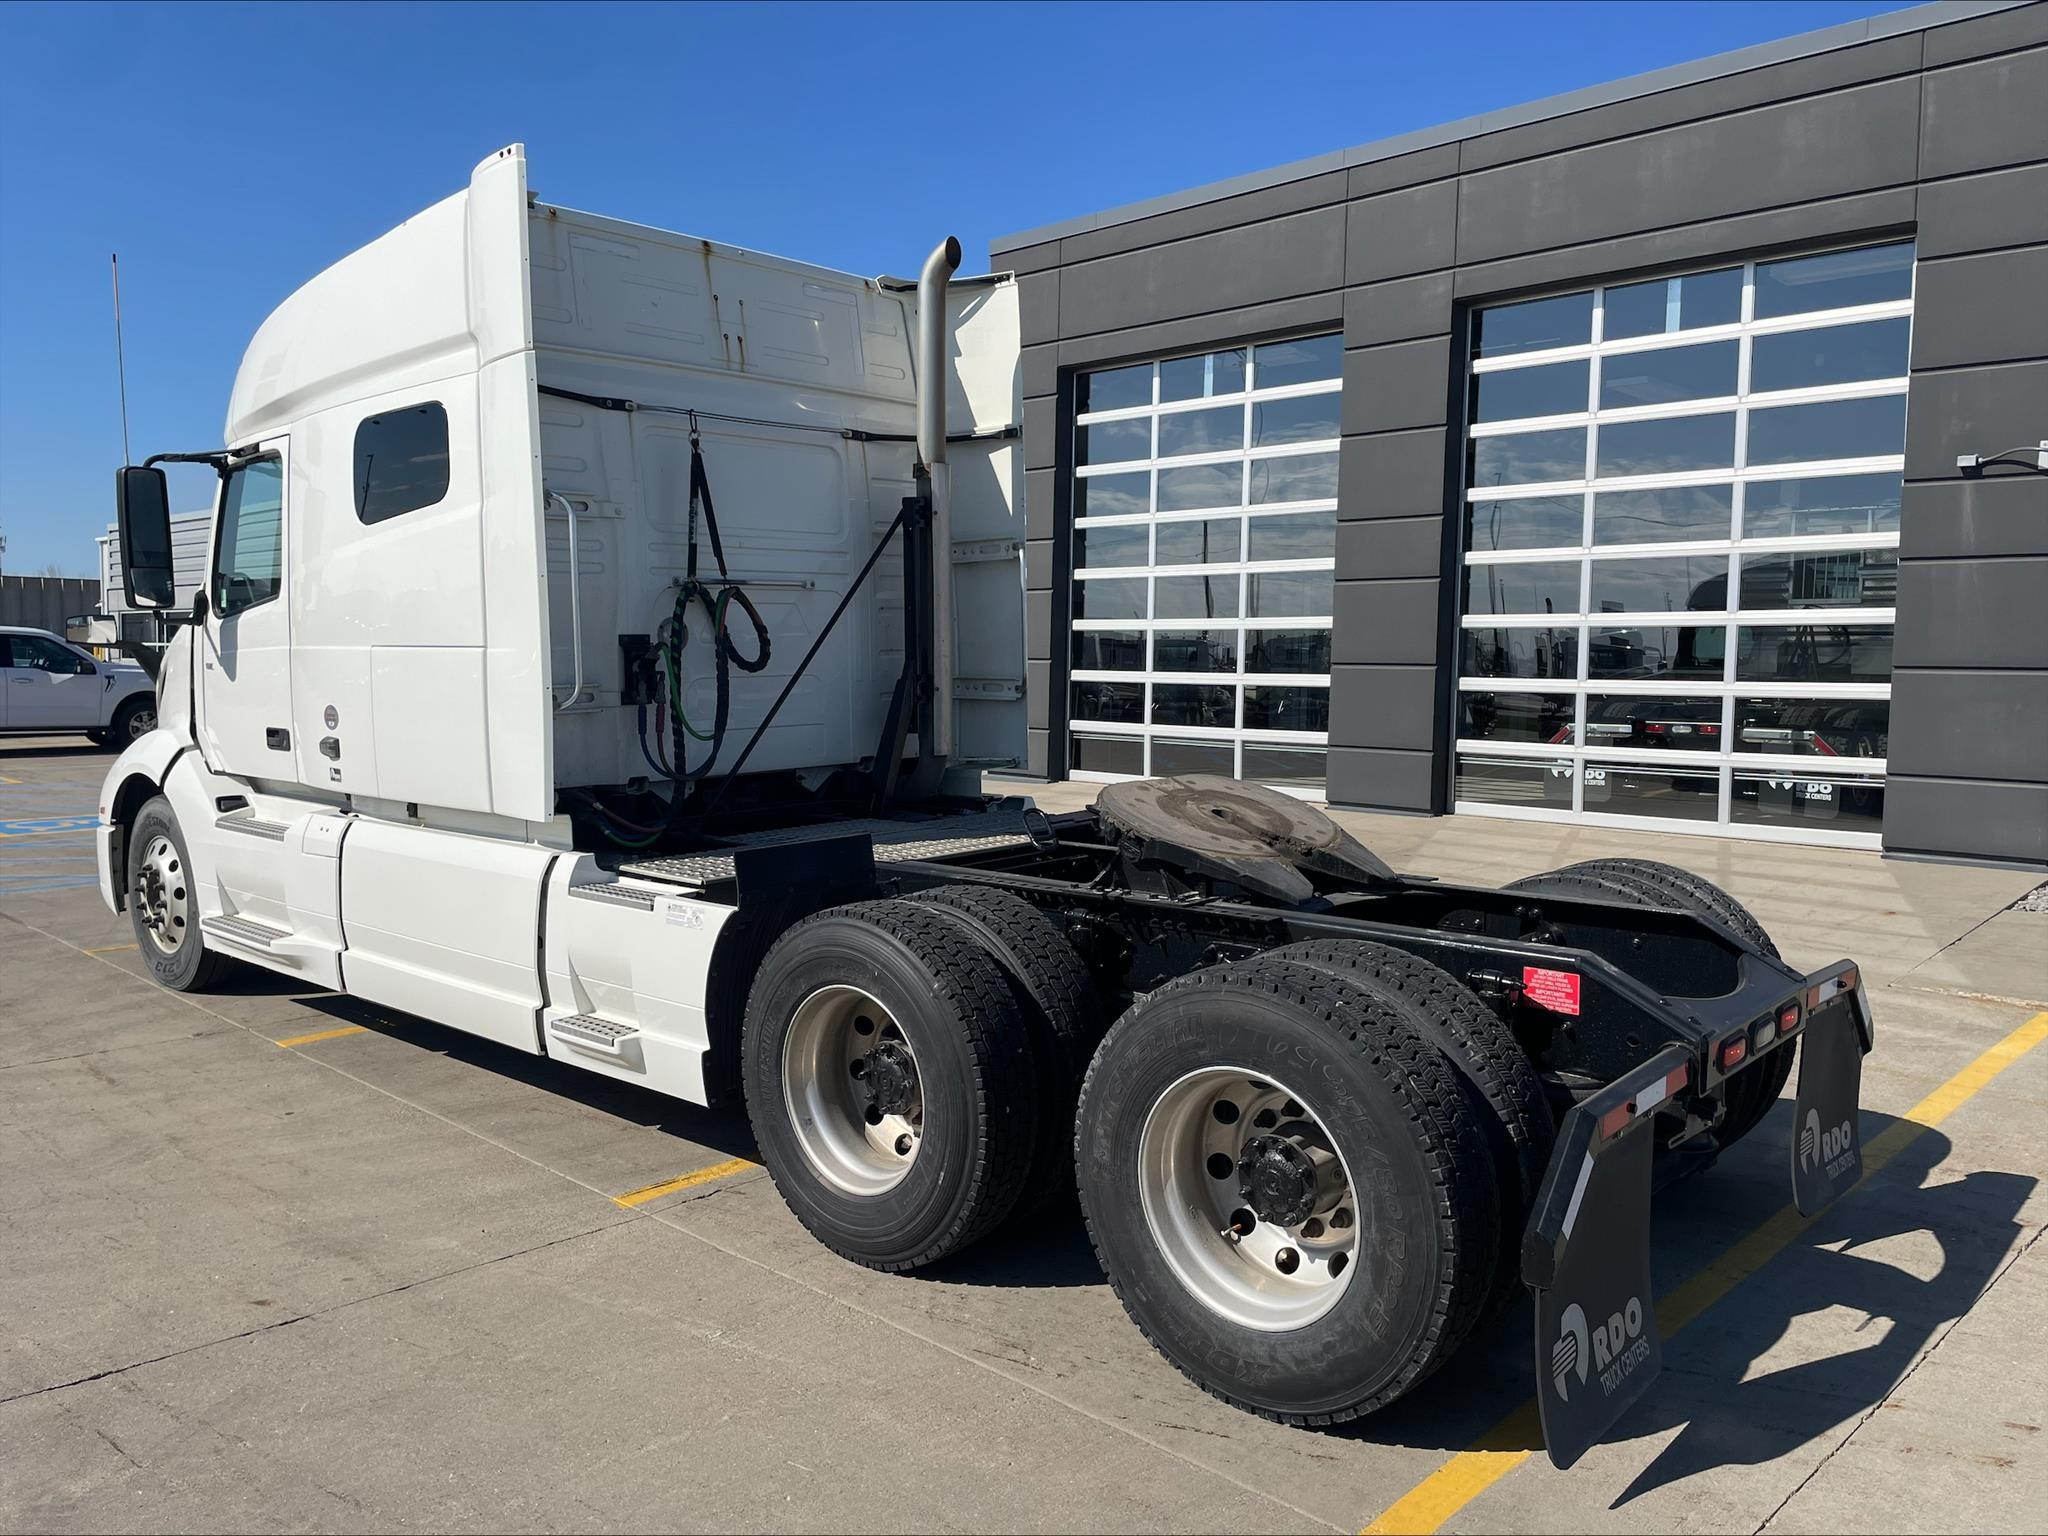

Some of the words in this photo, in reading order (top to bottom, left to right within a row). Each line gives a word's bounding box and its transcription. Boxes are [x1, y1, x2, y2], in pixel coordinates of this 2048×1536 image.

[1584, 769, 1606, 780] DO
[1822, 1120, 1852, 1163] RDO
[1592, 1296, 1643, 1373] RDO
[1600, 1359, 1625, 1397] TRUCK
[1620, 1335, 1651, 1377] CENTERS
